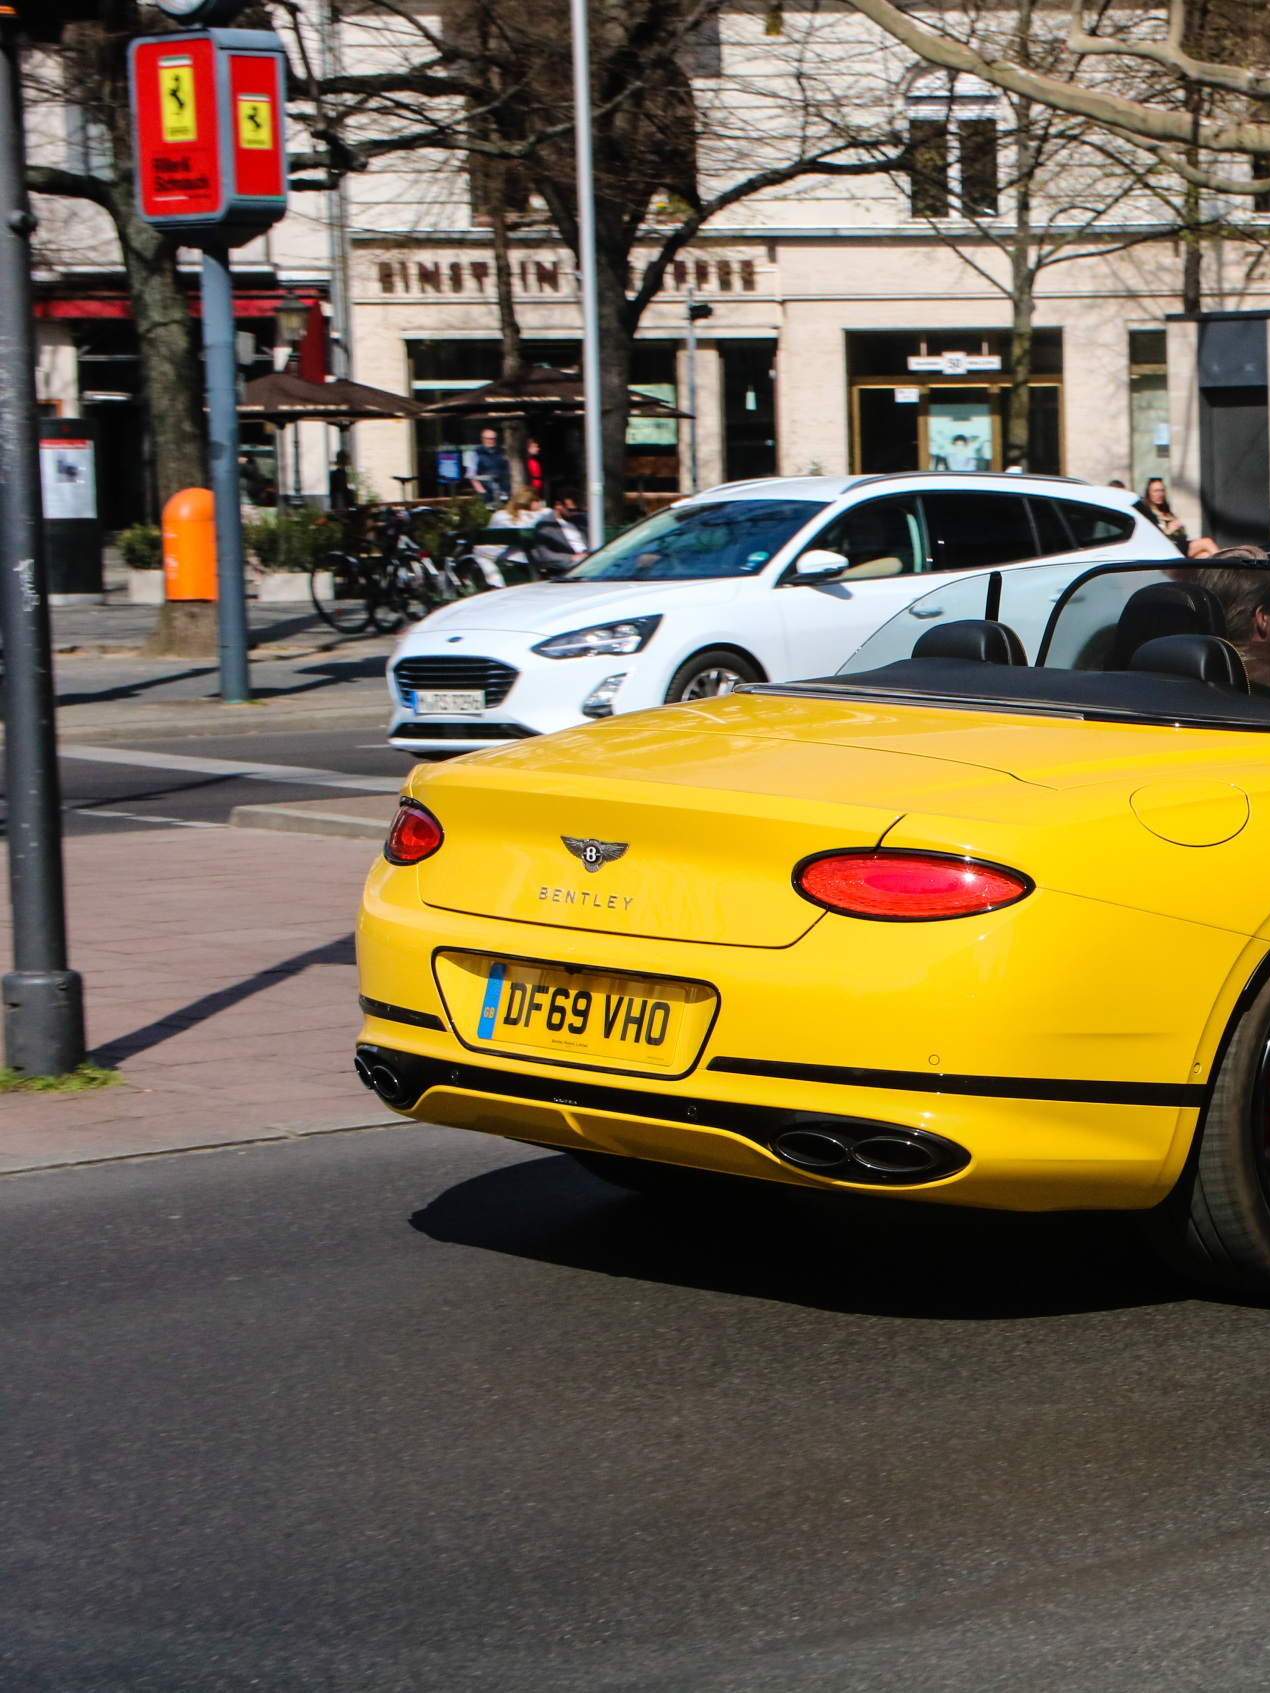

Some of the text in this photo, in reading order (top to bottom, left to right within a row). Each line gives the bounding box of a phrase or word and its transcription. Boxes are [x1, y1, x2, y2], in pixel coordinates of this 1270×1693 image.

[378, 261, 560, 294] EINSTIN
[538, 886, 634, 911] BENTLEY
[483, 1007, 496, 1019] GB
[503, 982, 671, 1046] DF69 VHO
